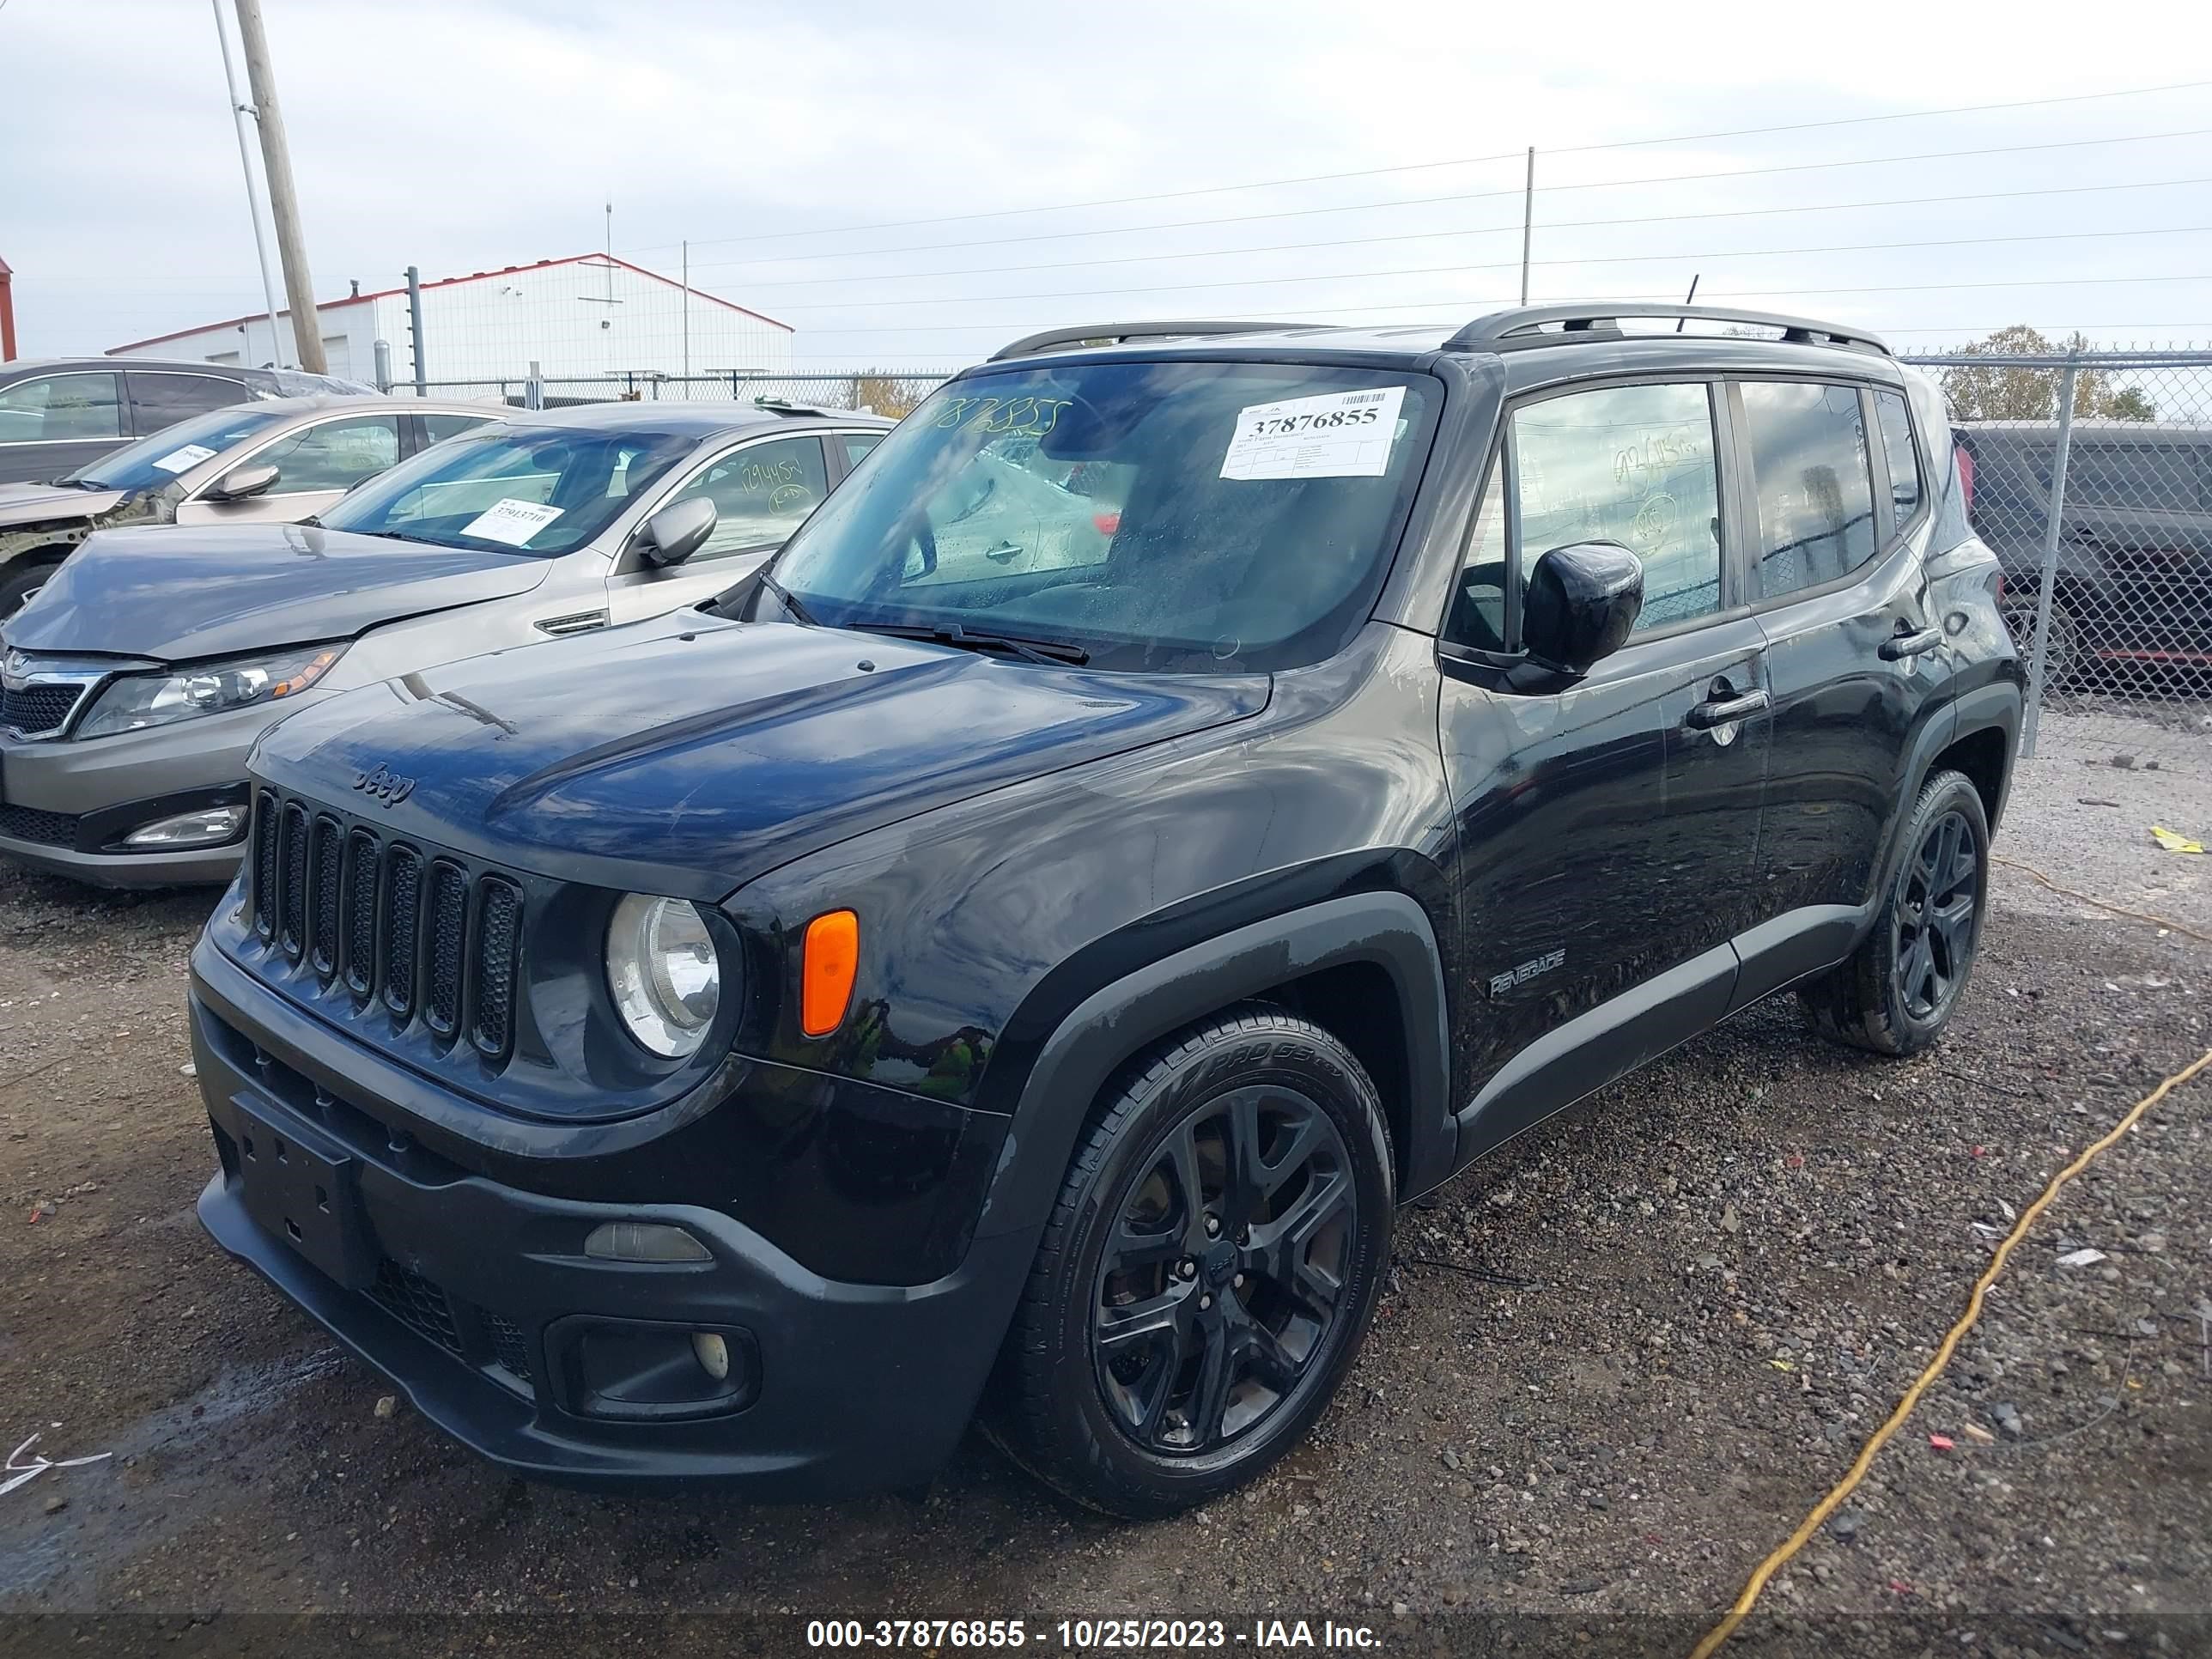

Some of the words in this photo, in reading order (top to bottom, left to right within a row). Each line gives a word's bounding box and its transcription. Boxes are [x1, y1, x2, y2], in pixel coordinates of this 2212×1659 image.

[907, 397, 1074, 436] 7876855
[1248, 407, 1379, 437] 37876855
[493, 507, 546, 522] 37913710
[352, 761, 416, 809] Jeep
[1490, 948, 1567, 999] RENEGADE
